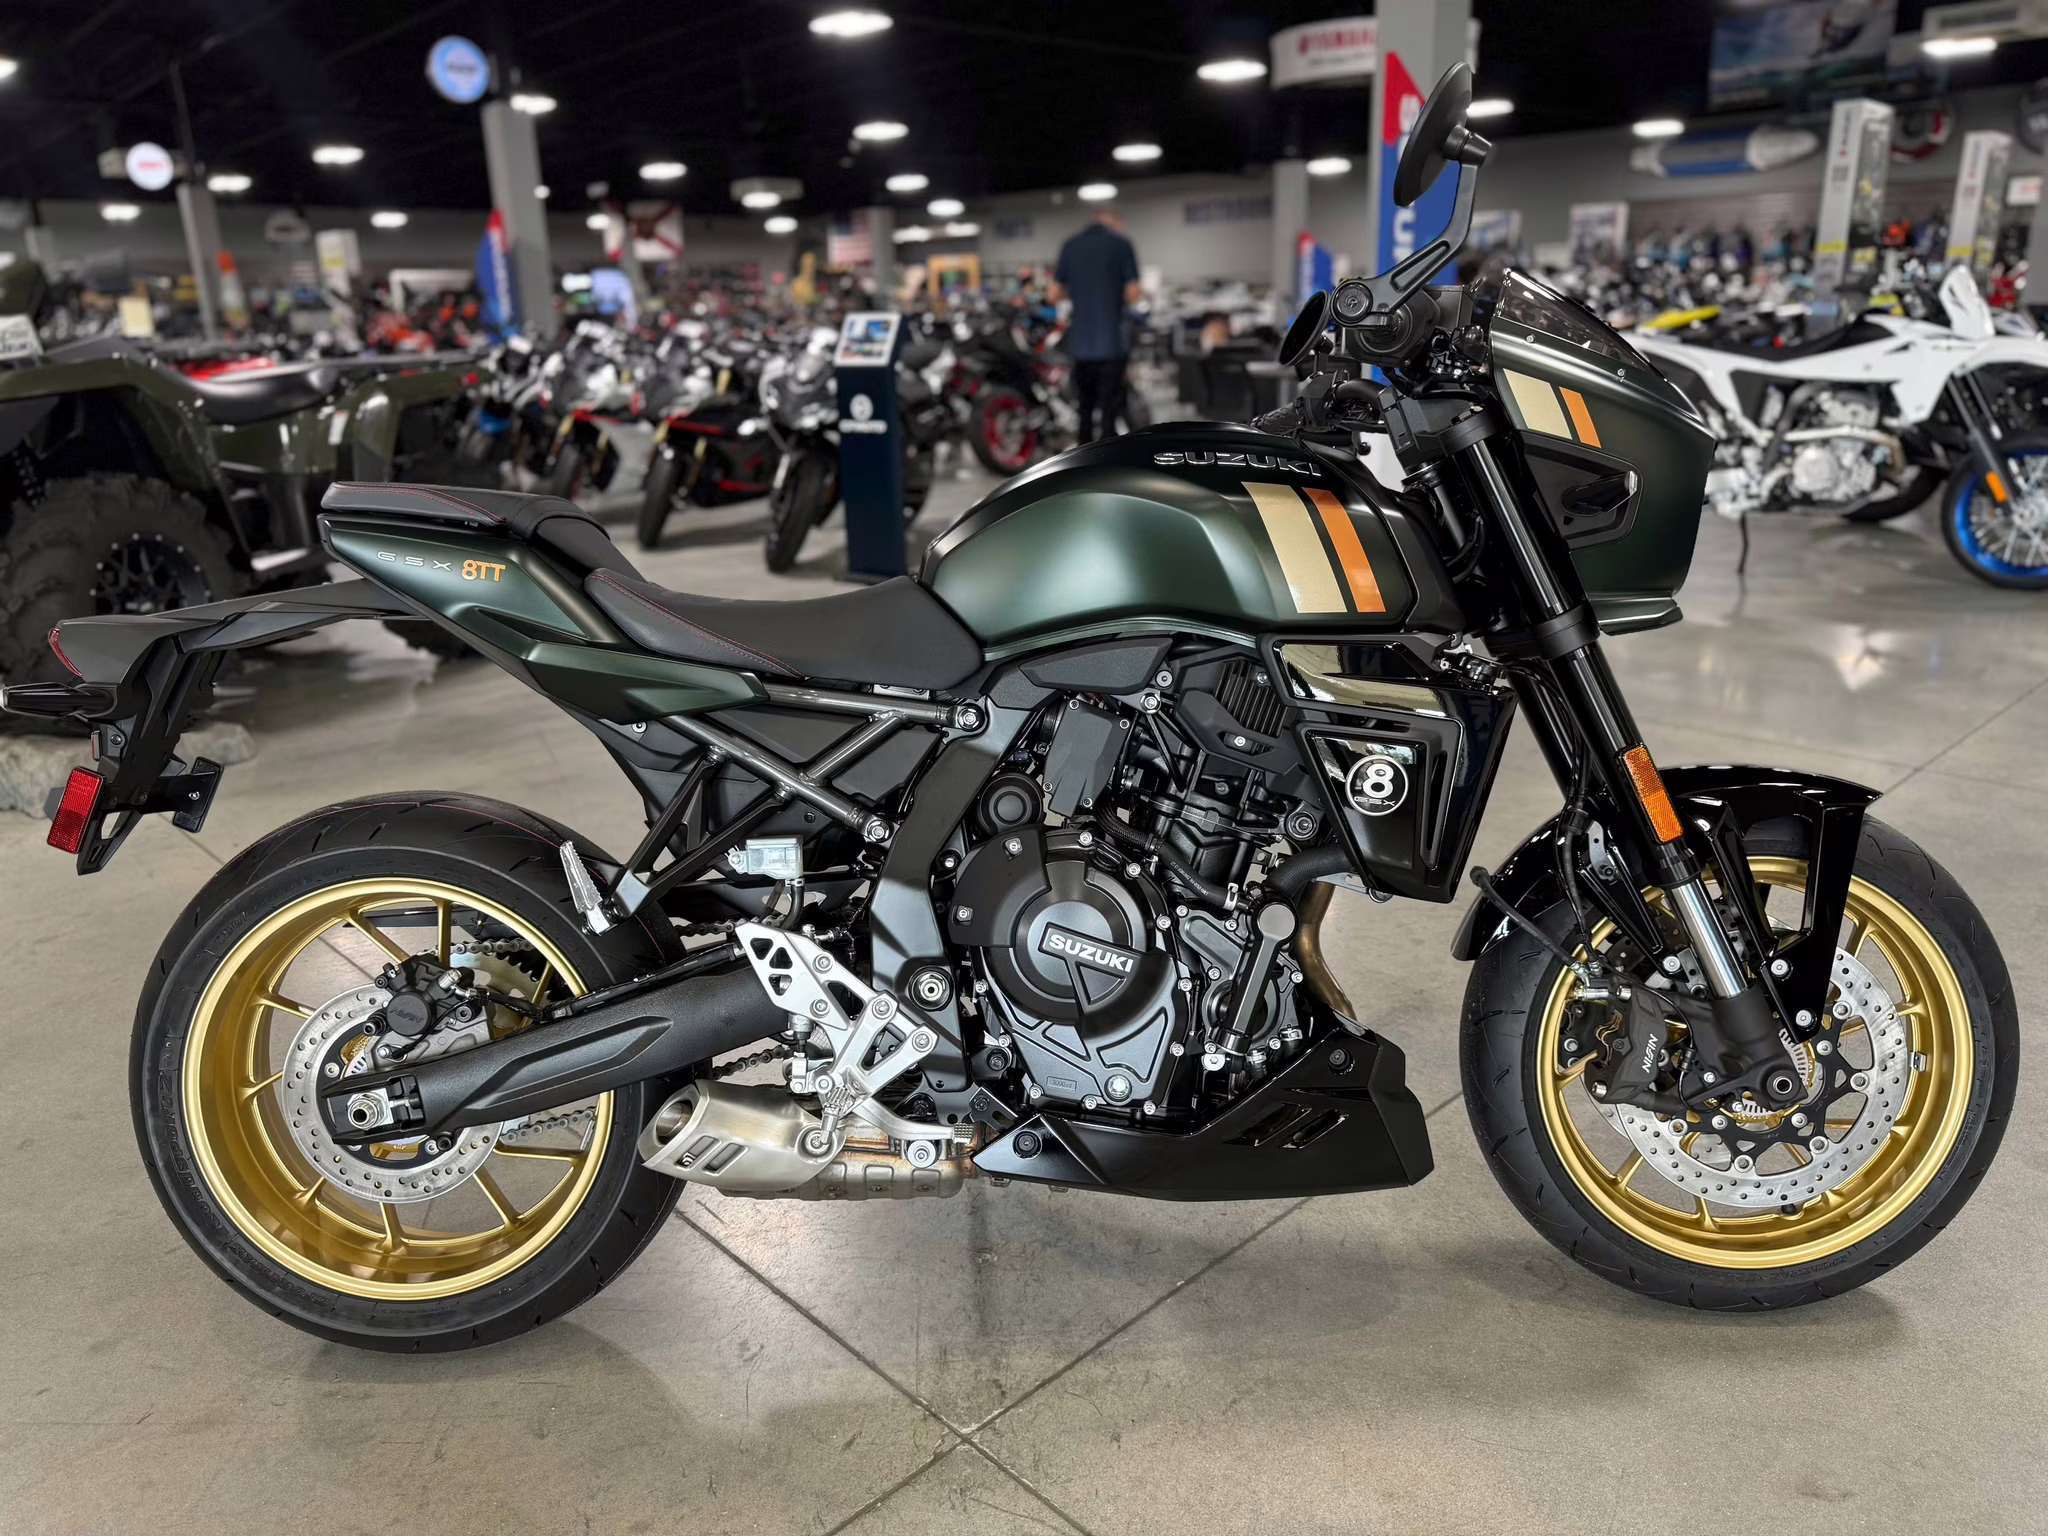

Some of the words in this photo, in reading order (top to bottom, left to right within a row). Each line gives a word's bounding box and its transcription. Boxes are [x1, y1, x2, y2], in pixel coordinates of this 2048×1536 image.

[1153, 451, 1322, 477] SUZUKI
[377, 551, 452, 572] GSX
[461, 559, 507, 582] 8TT
[1362, 763, 1394, 799] 8
[1353, 796, 1396, 807] GSX
[1049, 934, 1134, 973] SUZUKI
[1641, 1033, 1659, 1074] NISSIN
